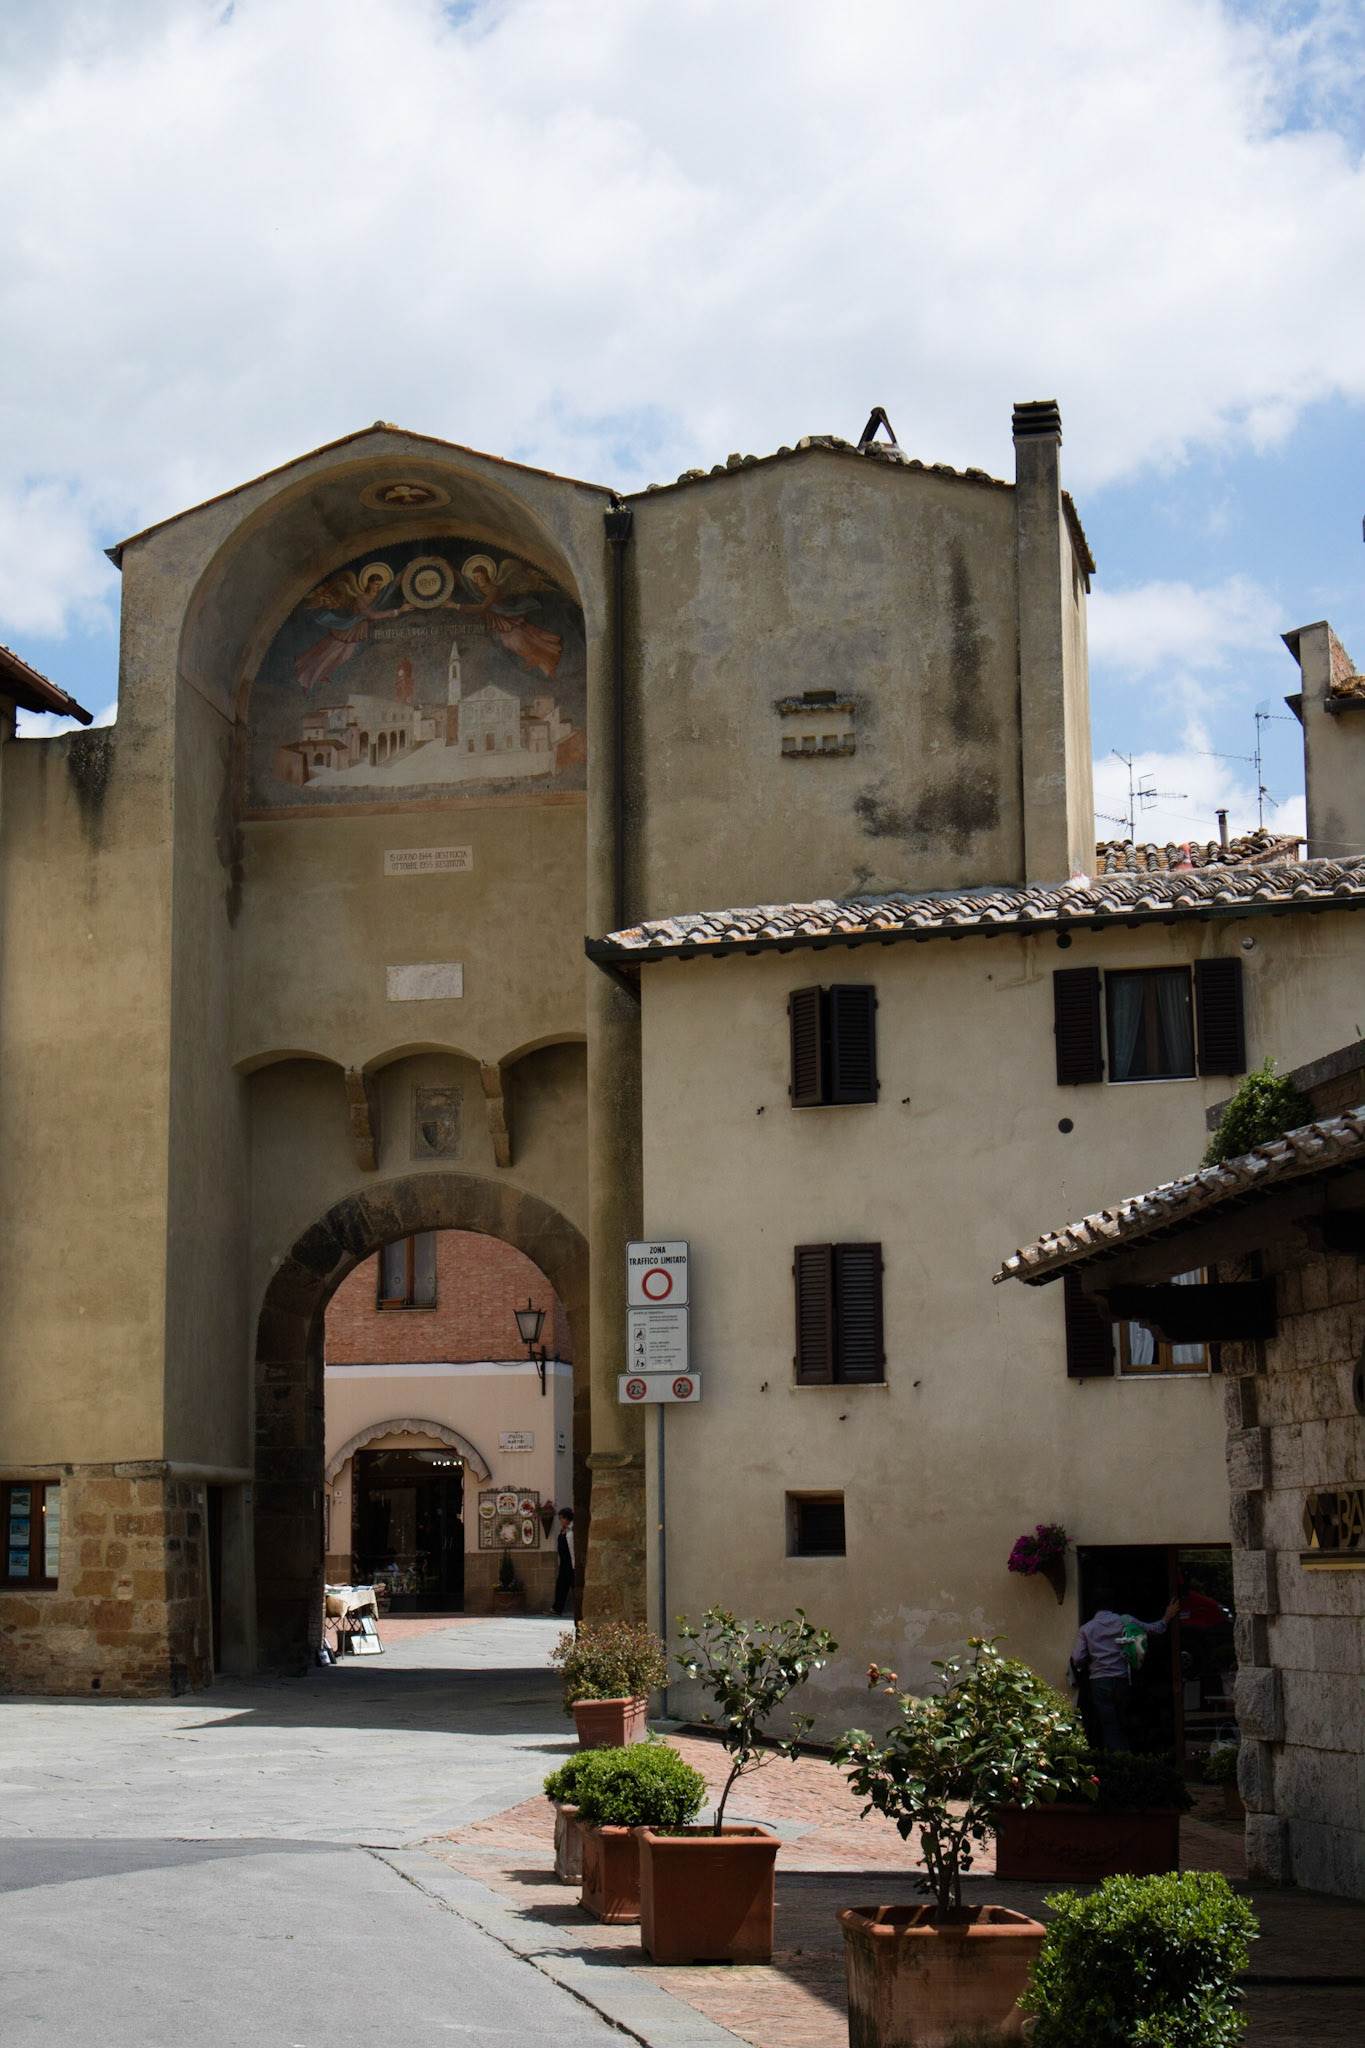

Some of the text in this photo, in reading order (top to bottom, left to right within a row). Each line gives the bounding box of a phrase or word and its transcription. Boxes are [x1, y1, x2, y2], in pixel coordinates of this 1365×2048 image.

[391, 861, 418, 871] OTTOBRE
[649, 1246, 666, 1254] ZONA
[629, 1255, 687, 1266] TRAFFICO LIMITATO
